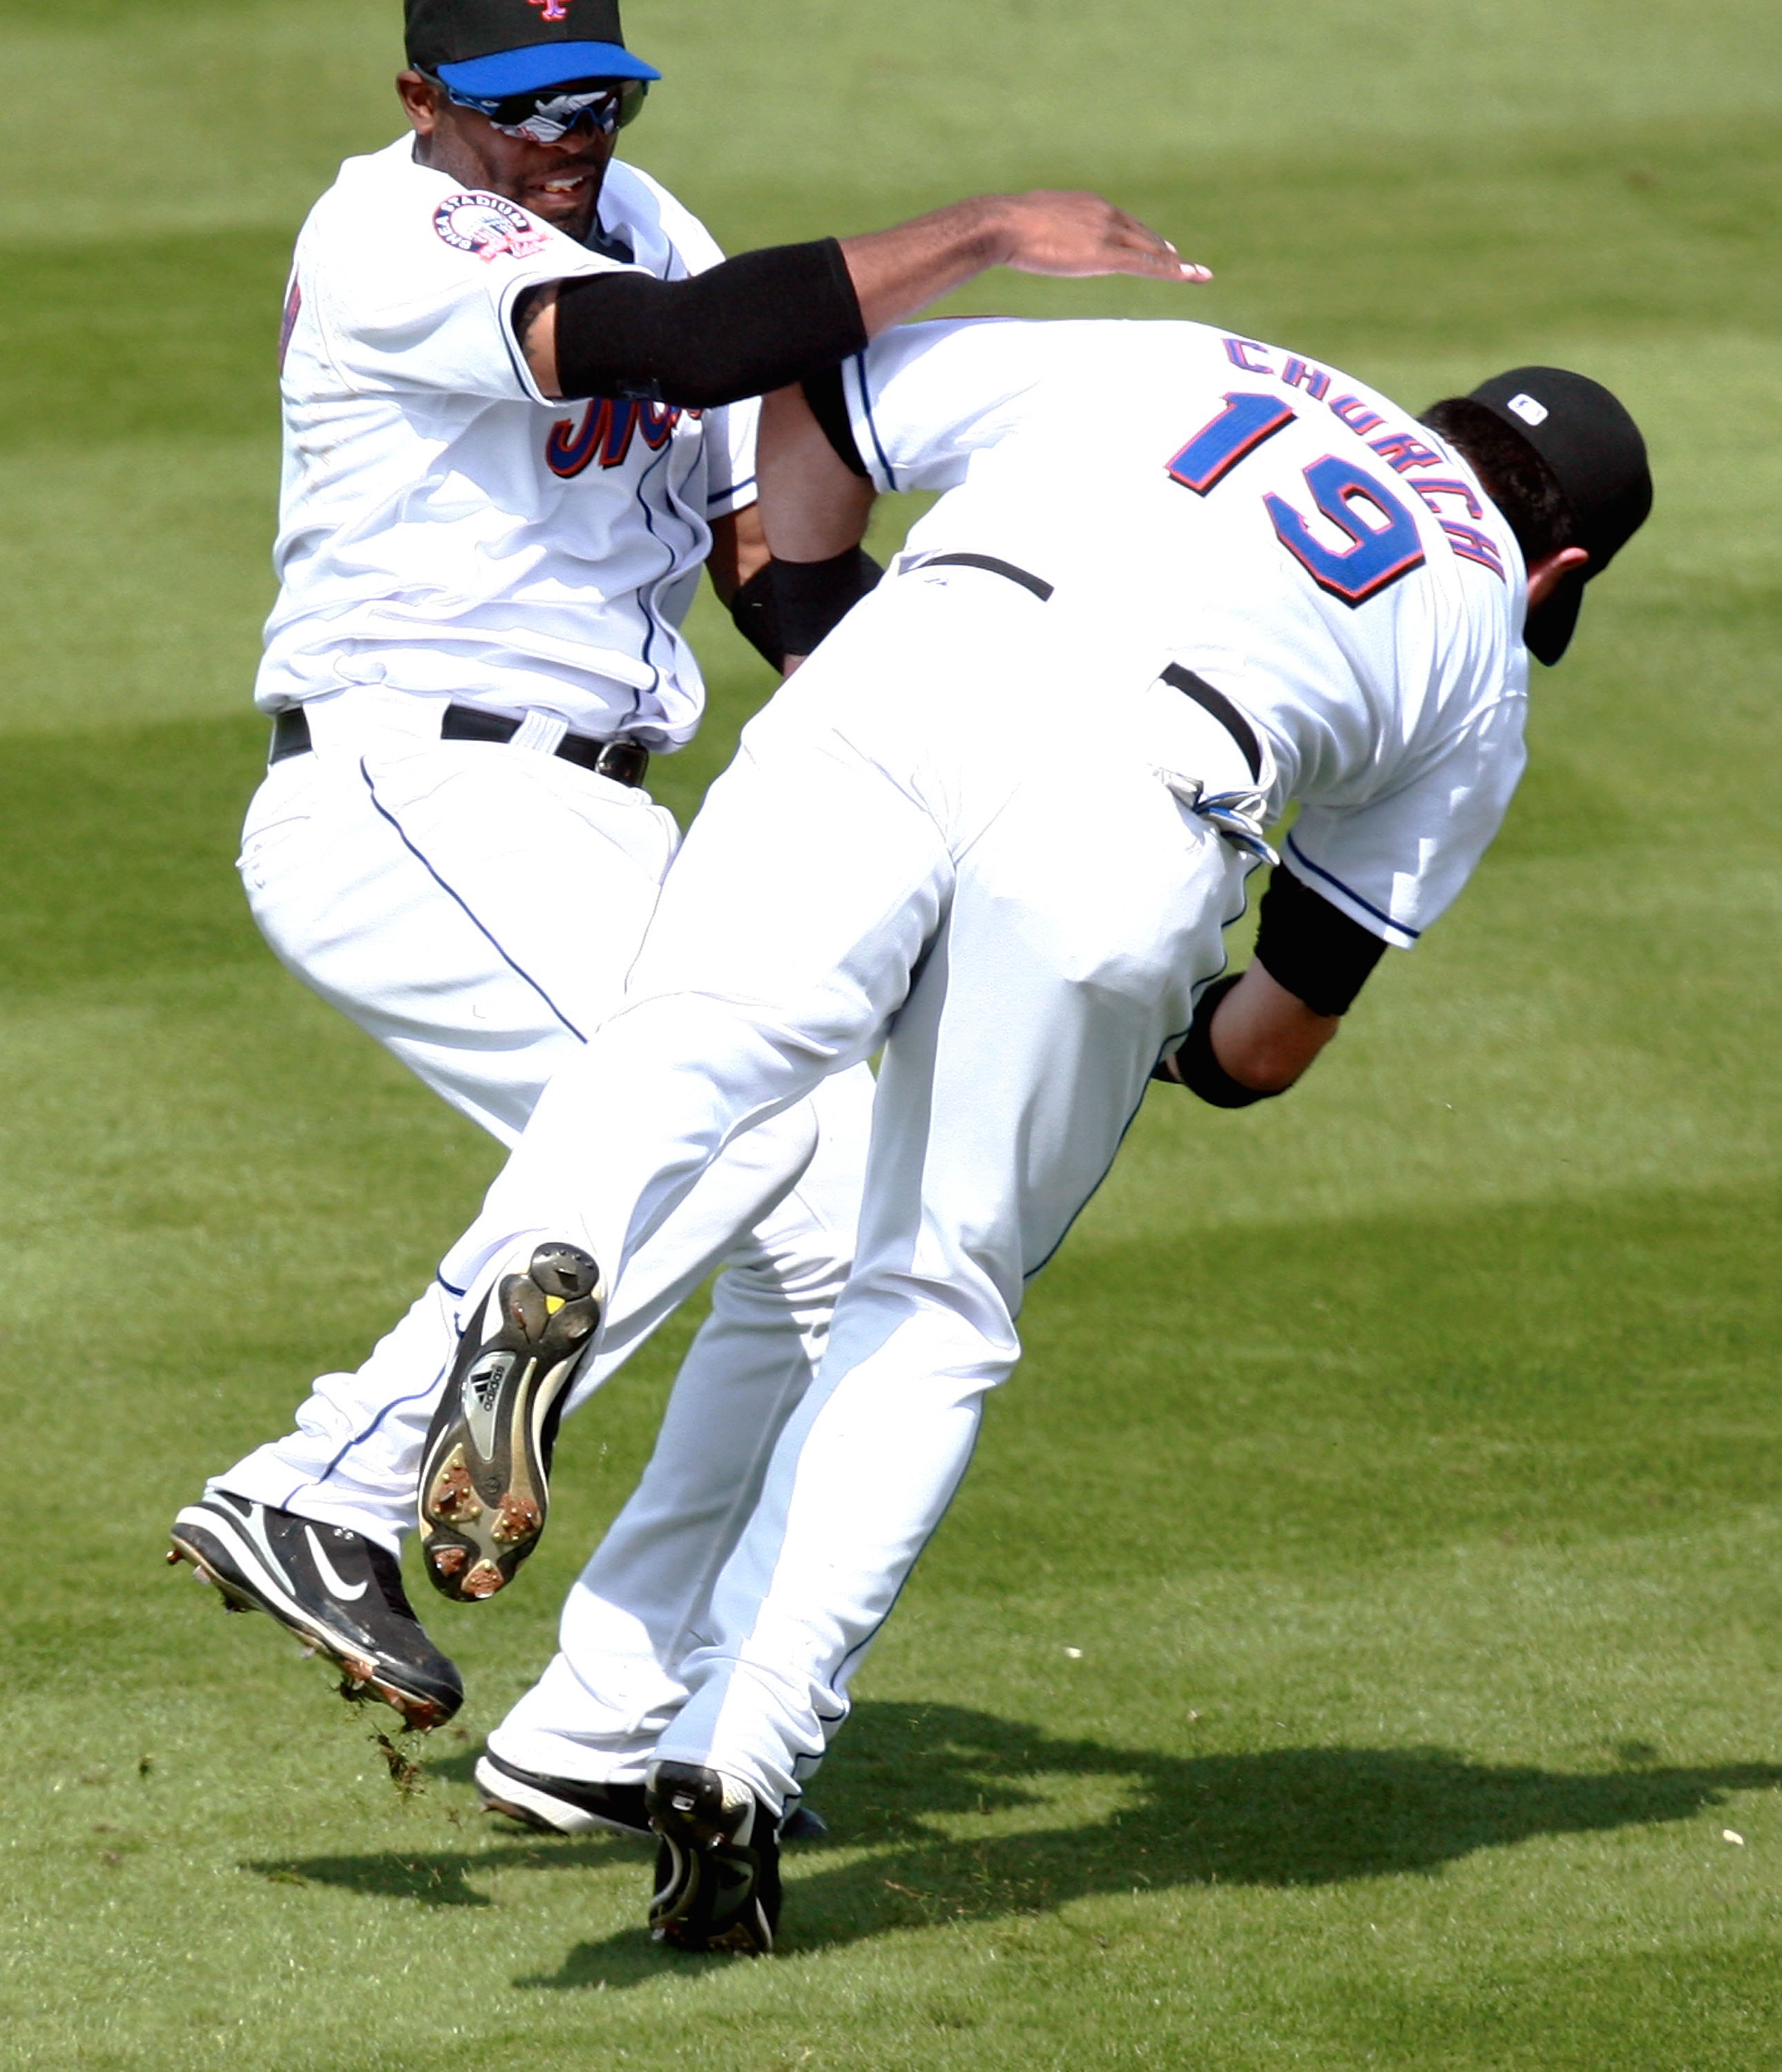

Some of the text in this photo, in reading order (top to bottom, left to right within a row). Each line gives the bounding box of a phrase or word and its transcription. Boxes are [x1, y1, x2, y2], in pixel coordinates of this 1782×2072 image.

[440, 195, 528, 229] STADIUM
[1165, 391, 1427, 611] 19
[1222, 337, 1508, 584] CHURCH
[484, 1365, 505, 1412] adidas
